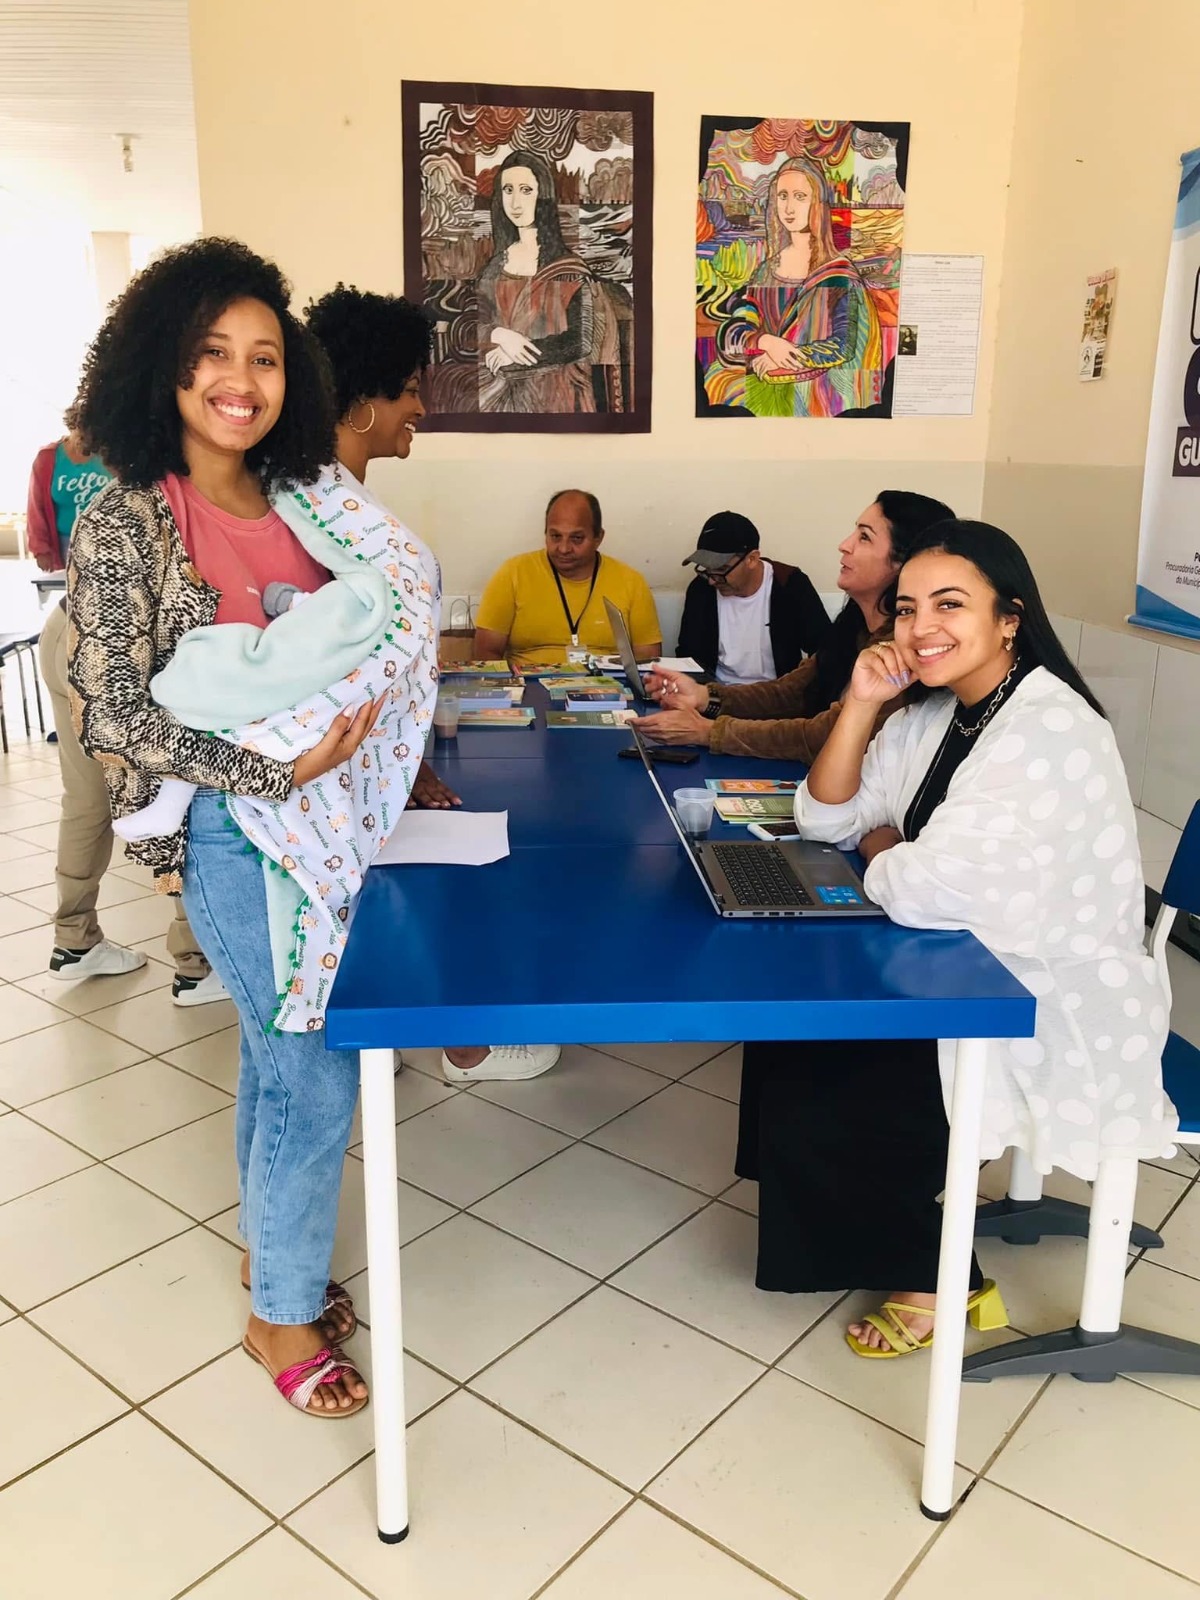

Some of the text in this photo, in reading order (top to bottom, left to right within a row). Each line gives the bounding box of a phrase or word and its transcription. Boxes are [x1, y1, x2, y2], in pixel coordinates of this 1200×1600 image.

[312, 781, 333, 812] Bernardo
[310, 820, 329, 849] Bernardo
[315, 977, 329, 1011] Bernardo
